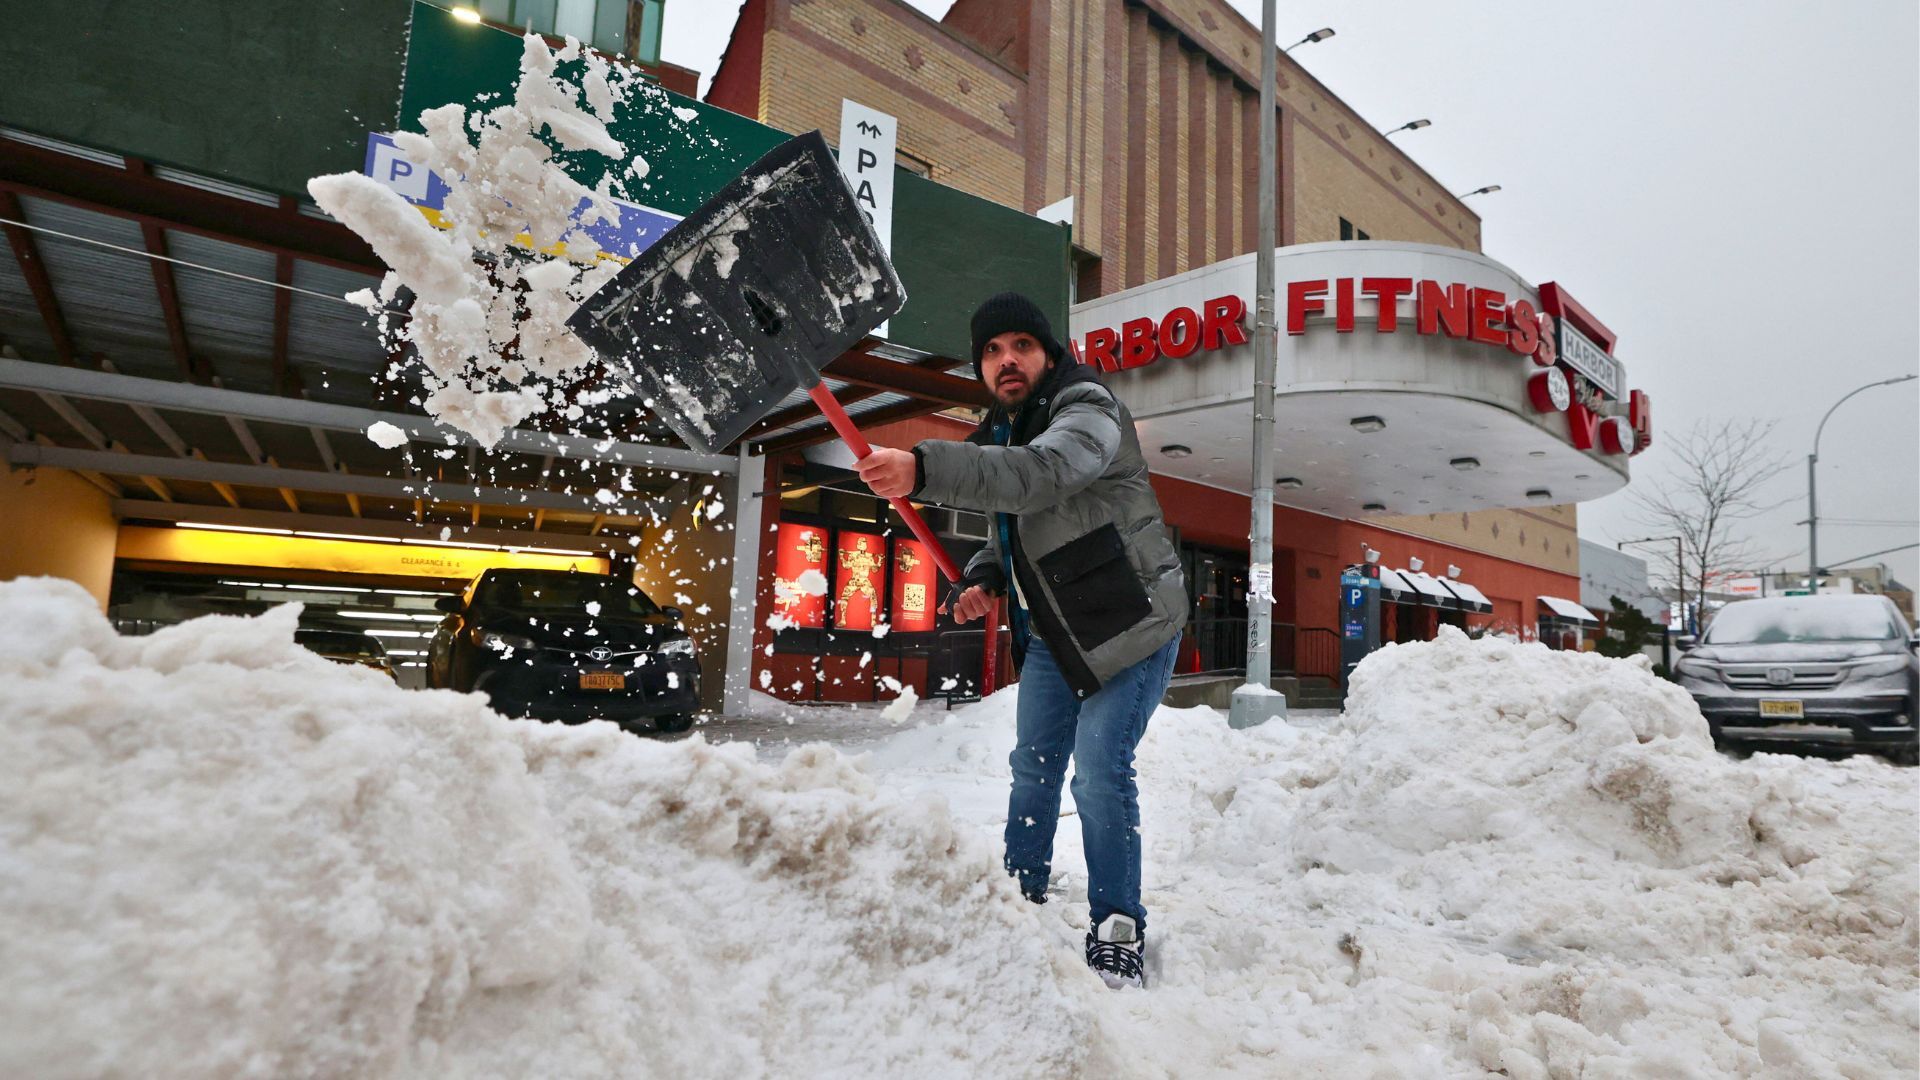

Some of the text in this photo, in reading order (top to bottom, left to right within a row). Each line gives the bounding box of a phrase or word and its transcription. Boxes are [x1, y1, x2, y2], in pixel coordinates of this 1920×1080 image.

[389, 158, 413, 182] P
[856, 147, 877, 226] PA
[1069, 277, 1557, 374] RBOR FITNESS
[1564, 331, 1615, 387] HARBOR
[401, 557, 443, 567] CLEARANCE
[1351, 588, 1362, 605] P
